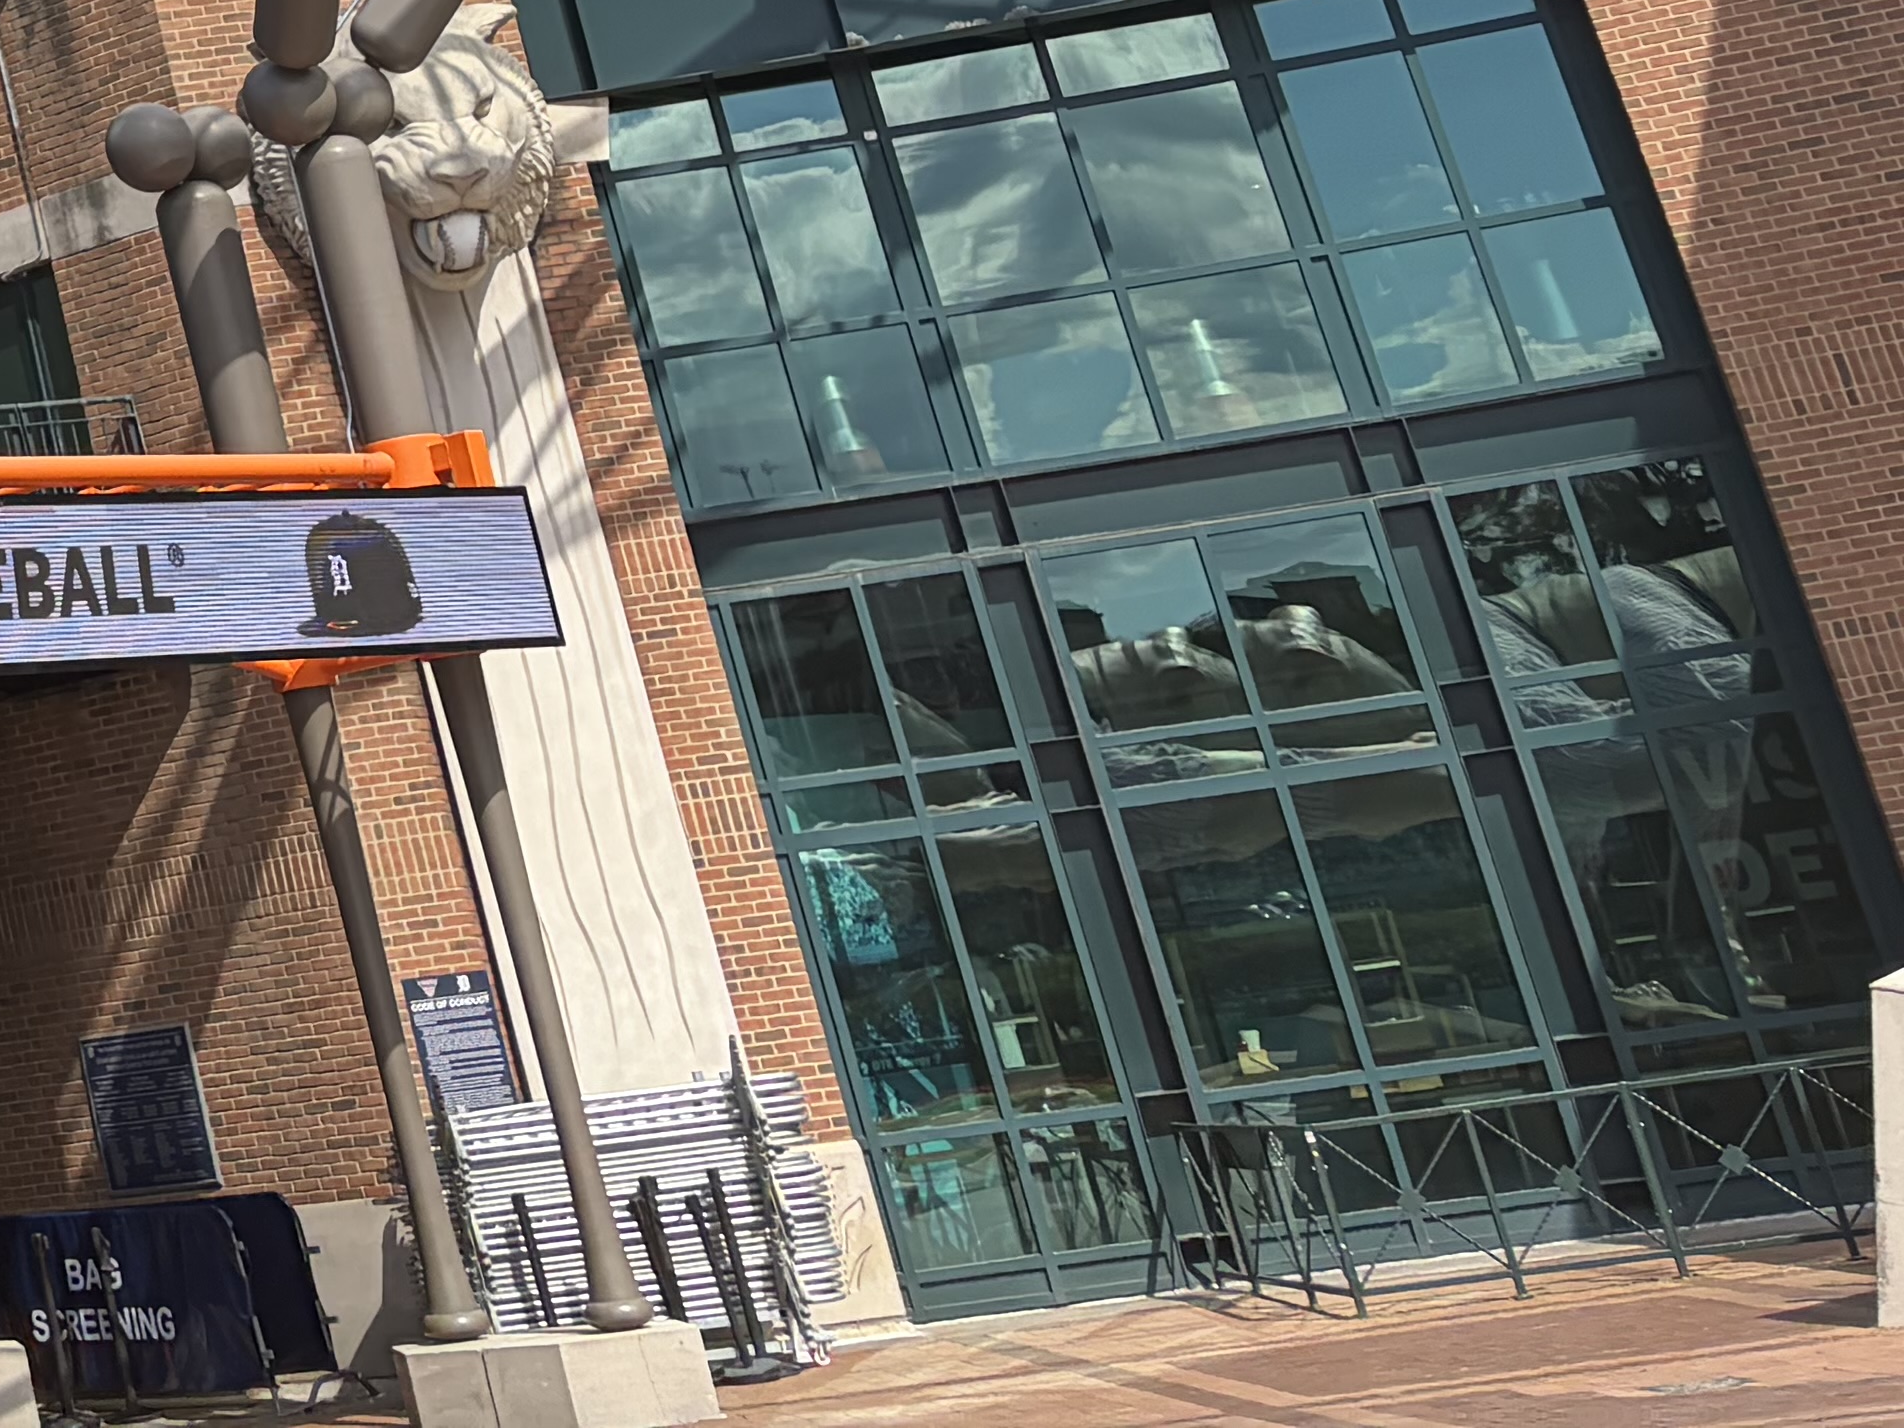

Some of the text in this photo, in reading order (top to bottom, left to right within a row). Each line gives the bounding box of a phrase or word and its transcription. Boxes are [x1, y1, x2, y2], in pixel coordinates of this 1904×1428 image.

[436, 999, 447, 1009] OF
[449, 994, 489, 1009] CONDUCT
[64, 1256, 123, 1292] BAG
